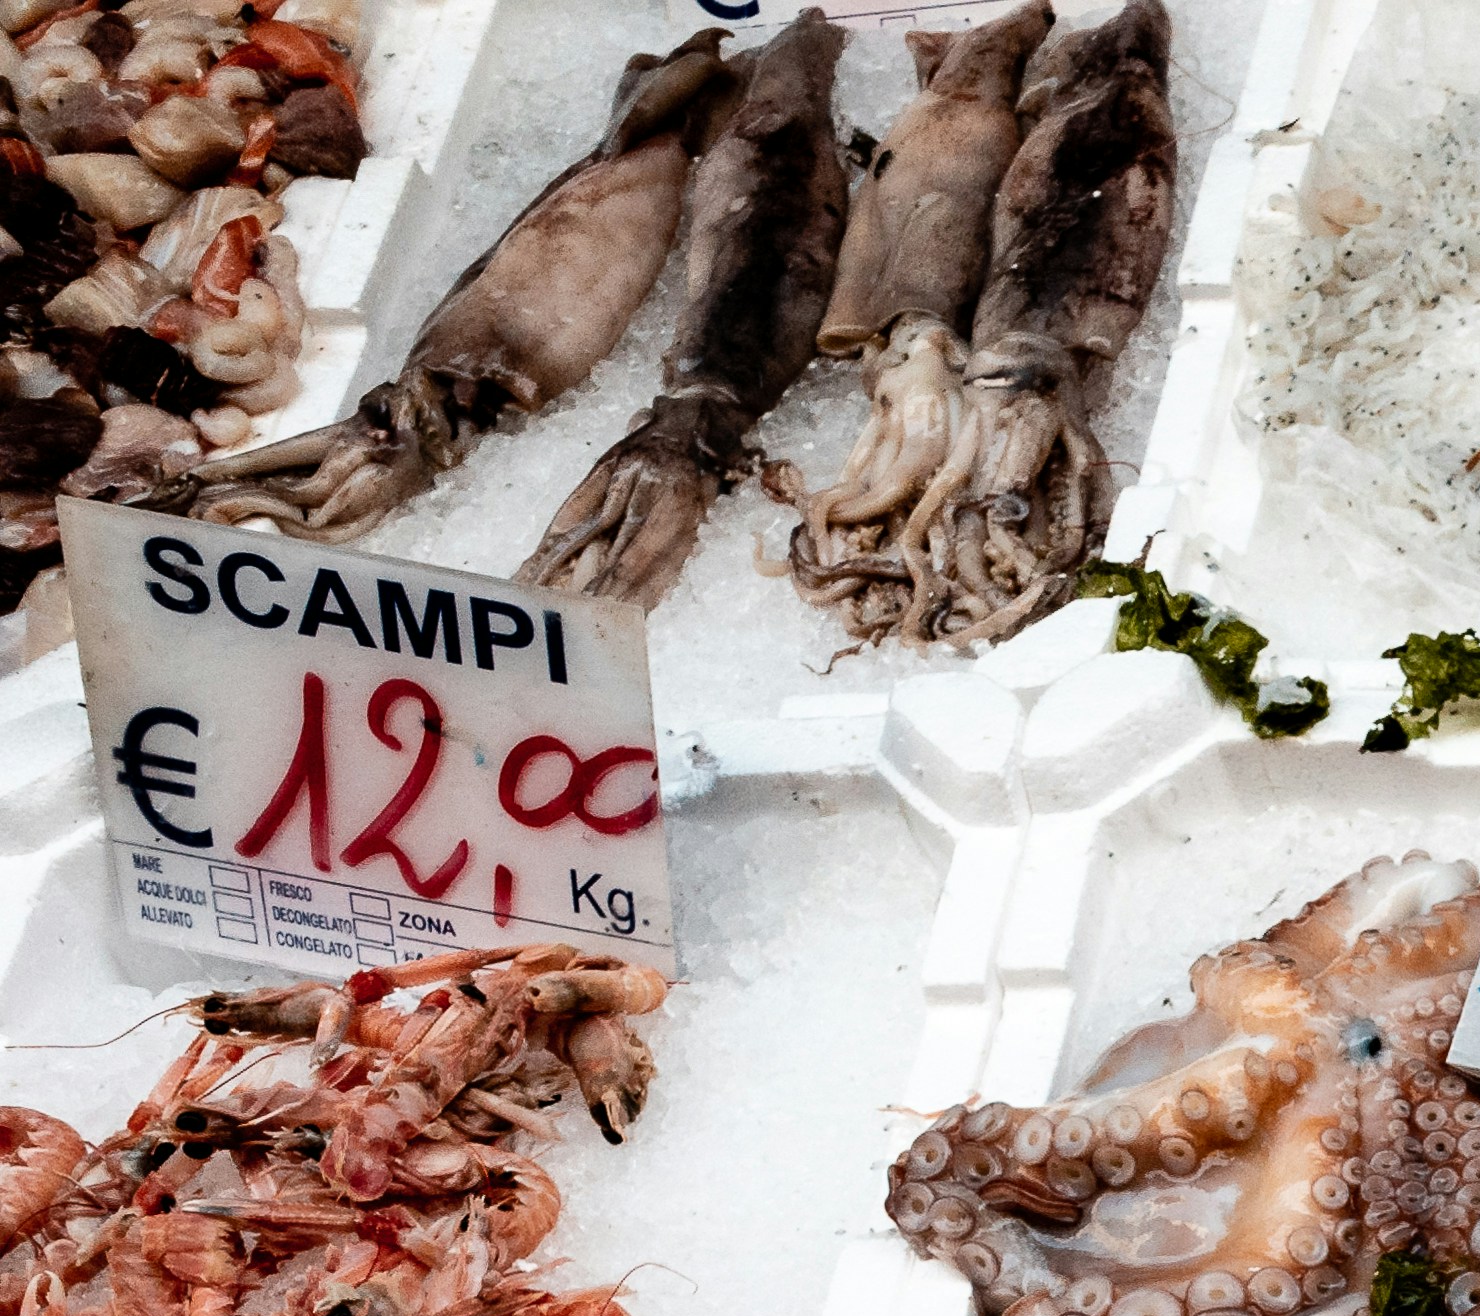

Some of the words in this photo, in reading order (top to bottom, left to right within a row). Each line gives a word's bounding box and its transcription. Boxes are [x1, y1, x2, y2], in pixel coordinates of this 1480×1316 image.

[144, 536, 568, 684] SCAMPI
[113, 707, 213, 848] €
[569, 868, 651, 934] Kg.
[132, 853, 163, 874] MARE
[137, 878, 173, 901] ACQUE
[174, 885, 207, 906] DOLCI
[269, 880, 312, 901] FRESCO
[141, 905, 193, 928] ALLEVATO
[272, 905, 353, 934] DECONGELATO
[399, 911, 457, 937] ZONA
[276, 931, 353, 959] CONGELATO
